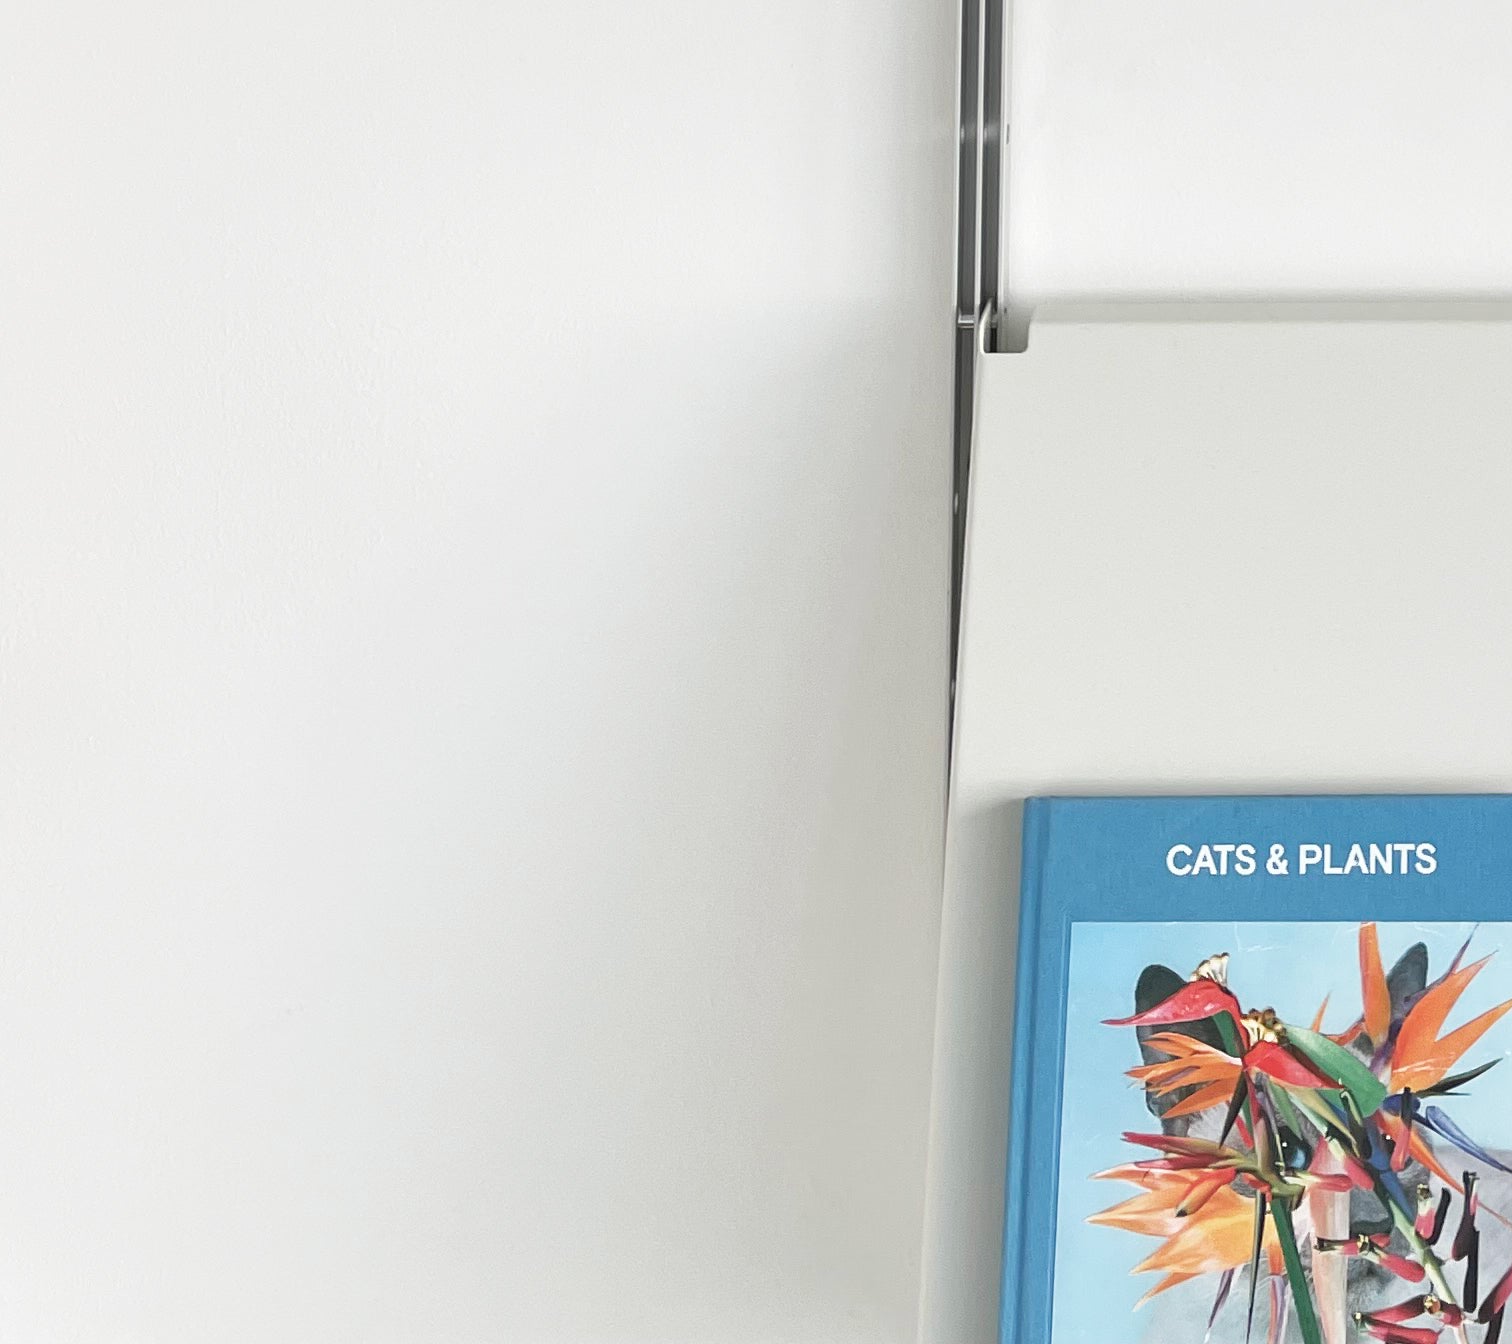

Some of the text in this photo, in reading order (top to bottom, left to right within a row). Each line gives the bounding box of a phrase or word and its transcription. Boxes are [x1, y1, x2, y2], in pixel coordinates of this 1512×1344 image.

[1167, 843, 1436, 875] CATS & PLANTS
